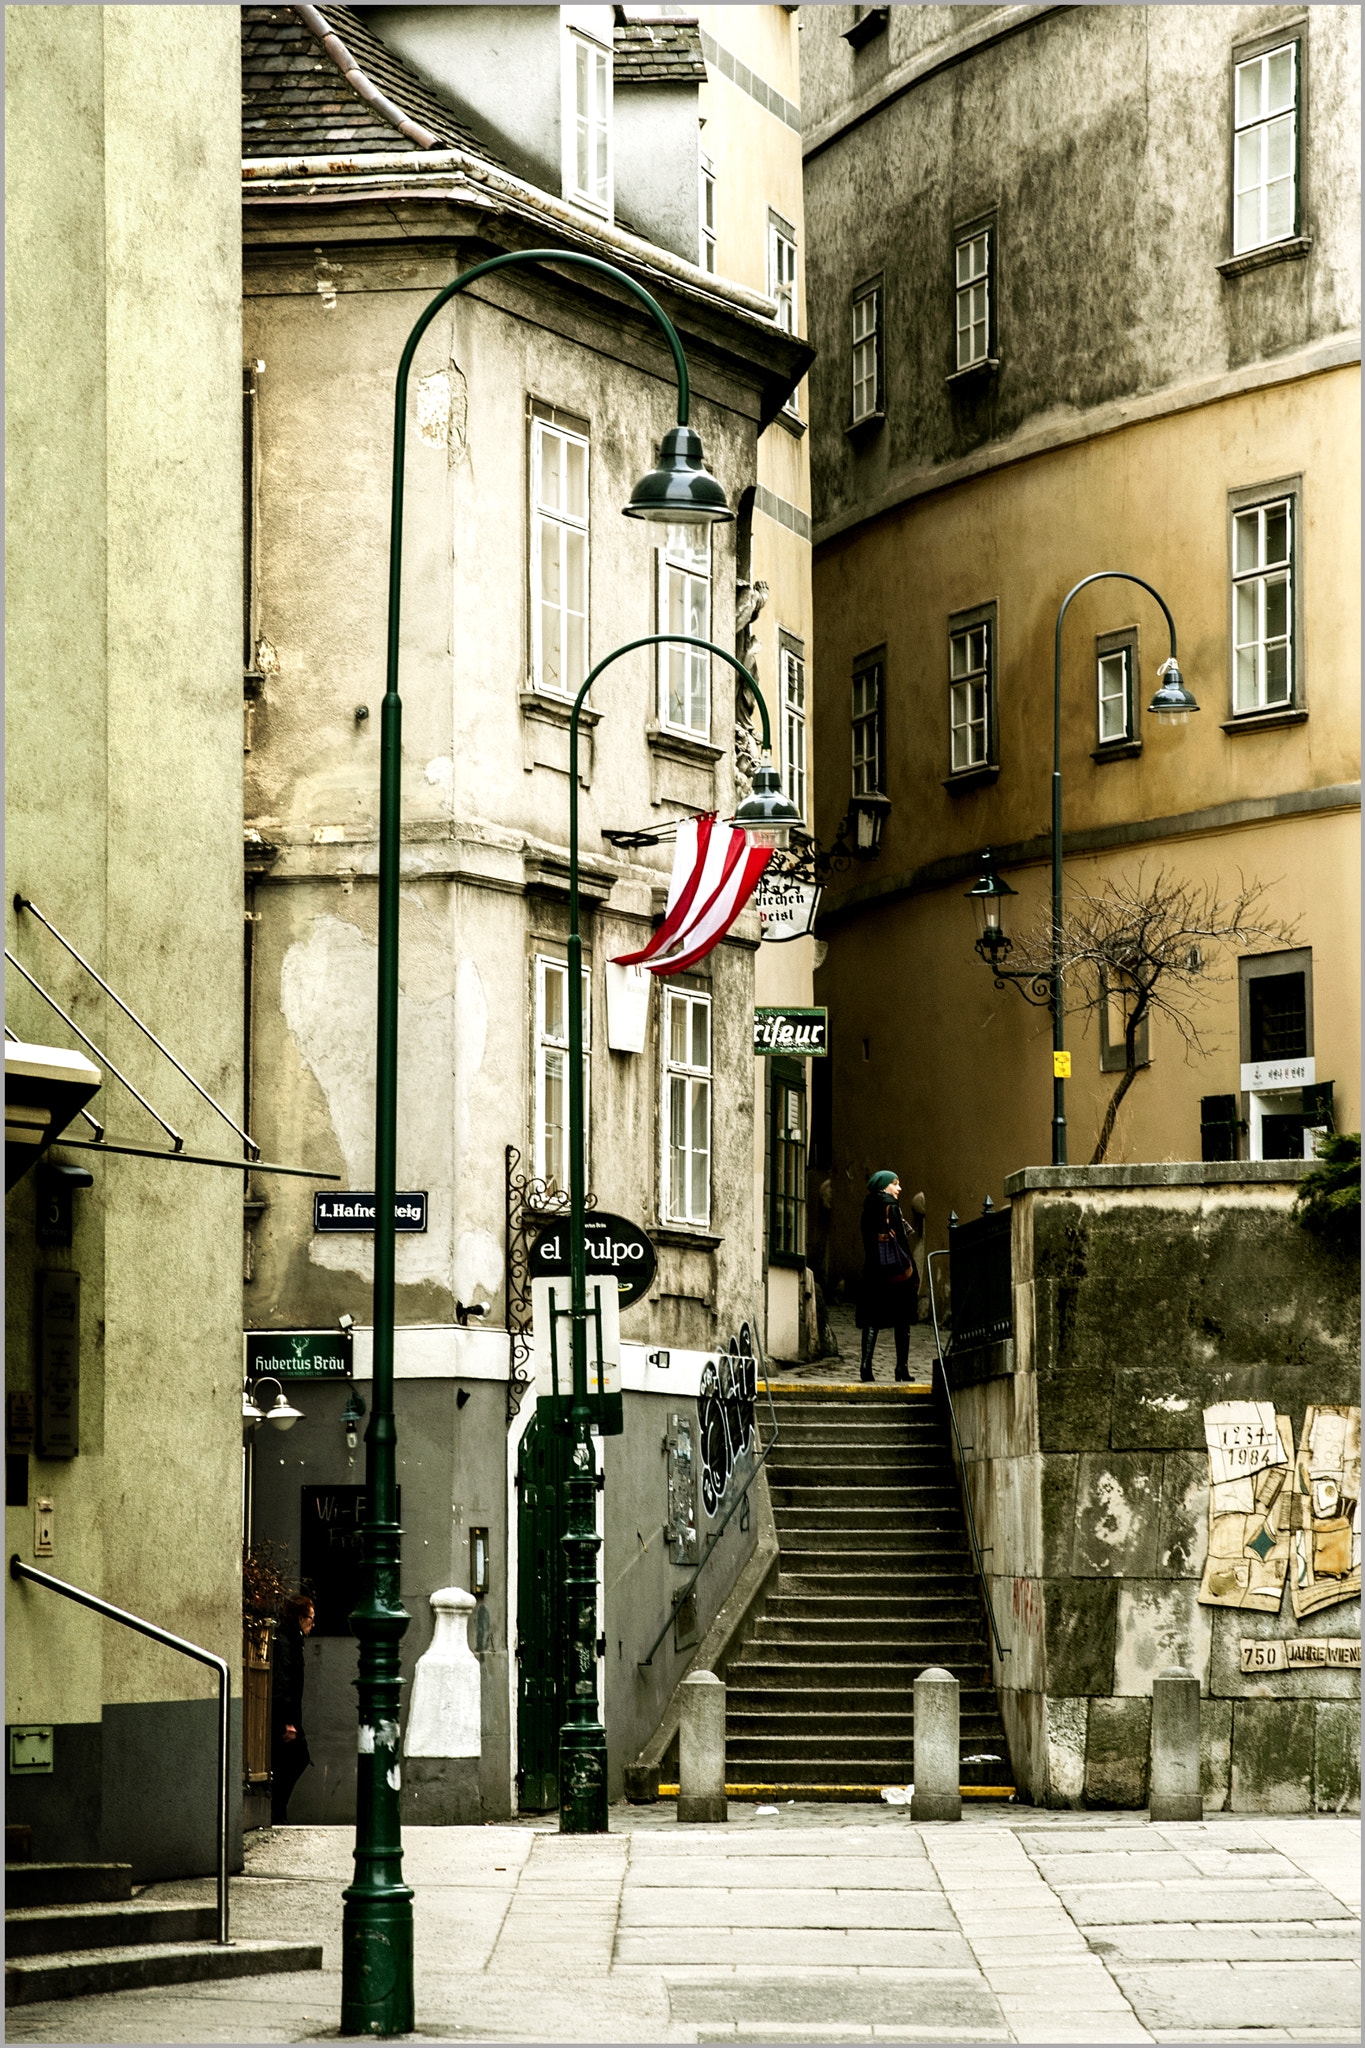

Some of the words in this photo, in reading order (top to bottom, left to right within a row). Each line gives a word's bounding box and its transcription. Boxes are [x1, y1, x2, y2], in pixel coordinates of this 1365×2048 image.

[540, 1236, 561, 1259] el
[255, 1356, 311, 1371] Hubertus
[313, 1355, 345, 1370] Bräu
[1228, 1449, 1270, 1466] 1984
[316, 1496, 366, 1522] Wi-F
[1244, 1648, 1276, 1665] 750
[1289, 1646, 1325, 1661] JAHRE
